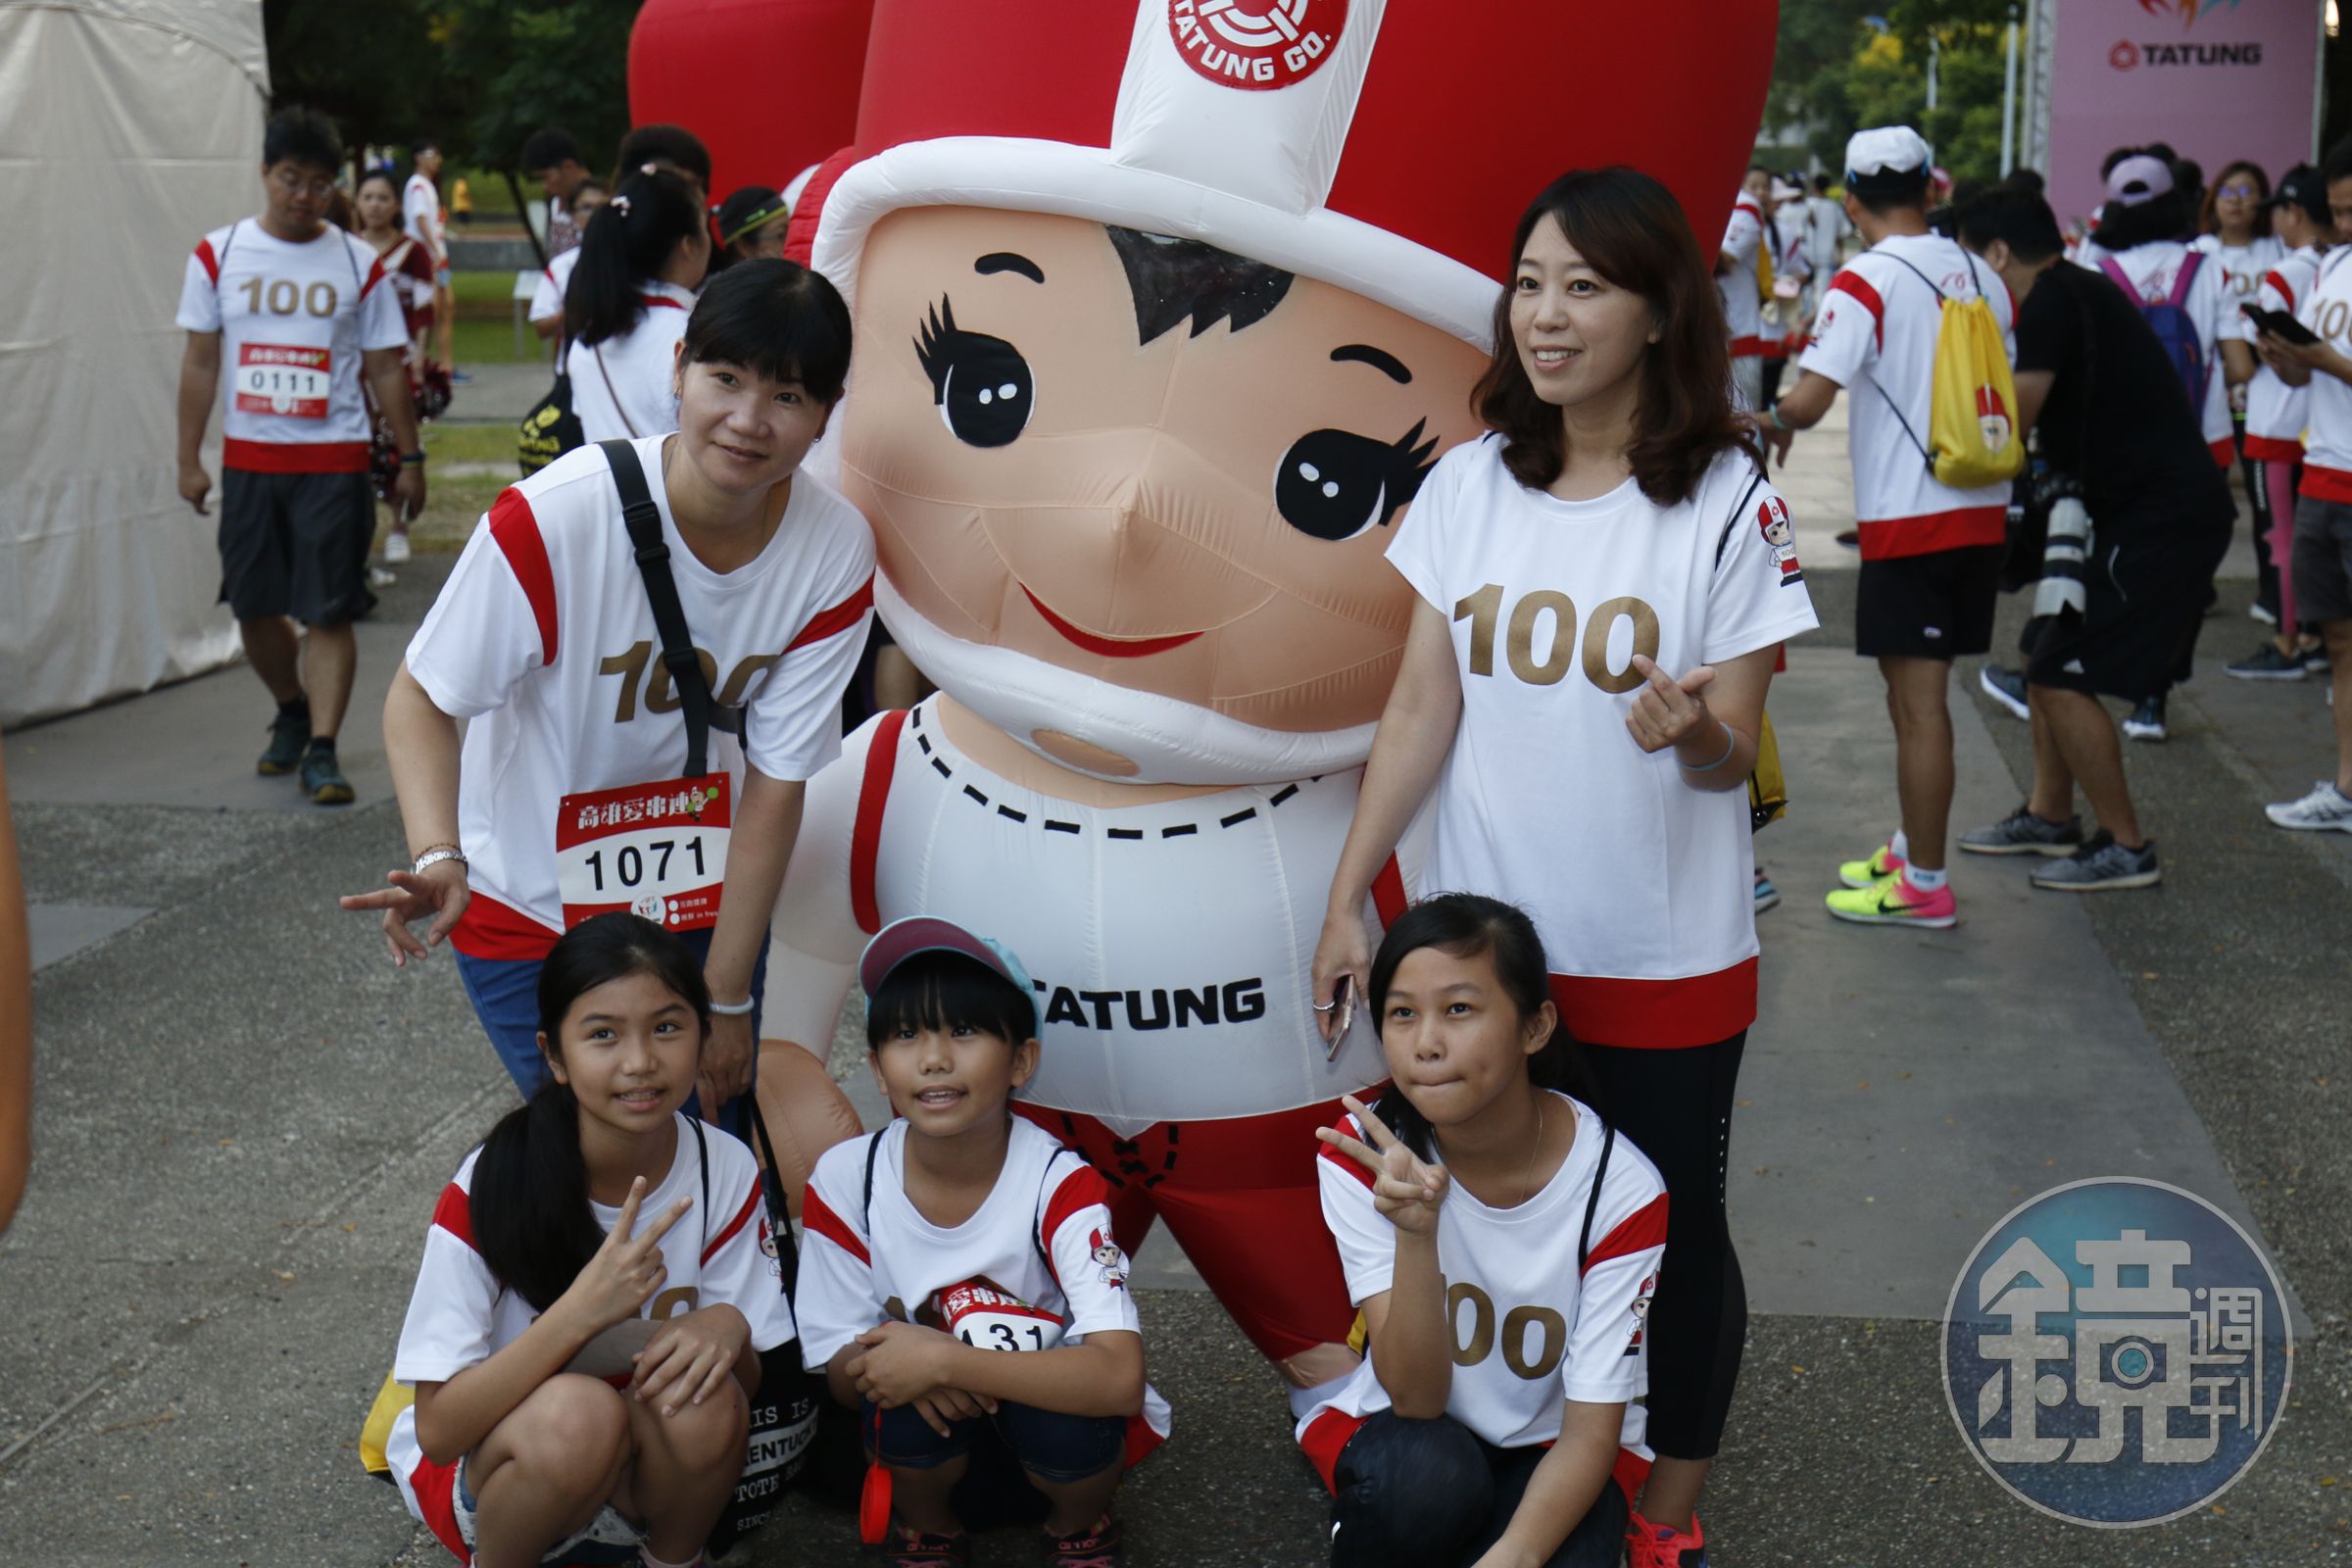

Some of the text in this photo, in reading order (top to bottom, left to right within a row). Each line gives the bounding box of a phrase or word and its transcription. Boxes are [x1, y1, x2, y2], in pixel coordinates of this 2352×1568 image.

[1174, 0, 1332, 81] TATUNG CO.
[2143, 43, 2263, 66] TATUNG
[239, 275, 337, 318] 100
[2314, 298, 2352, 340] 10
[251, 369, 316, 392] 0111
[1454, 582, 1660, 694] 100
[585, 835, 706, 892] 1071
[1447, 1282, 1567, 1381] 00
[750, 1405, 778, 1429] IS
